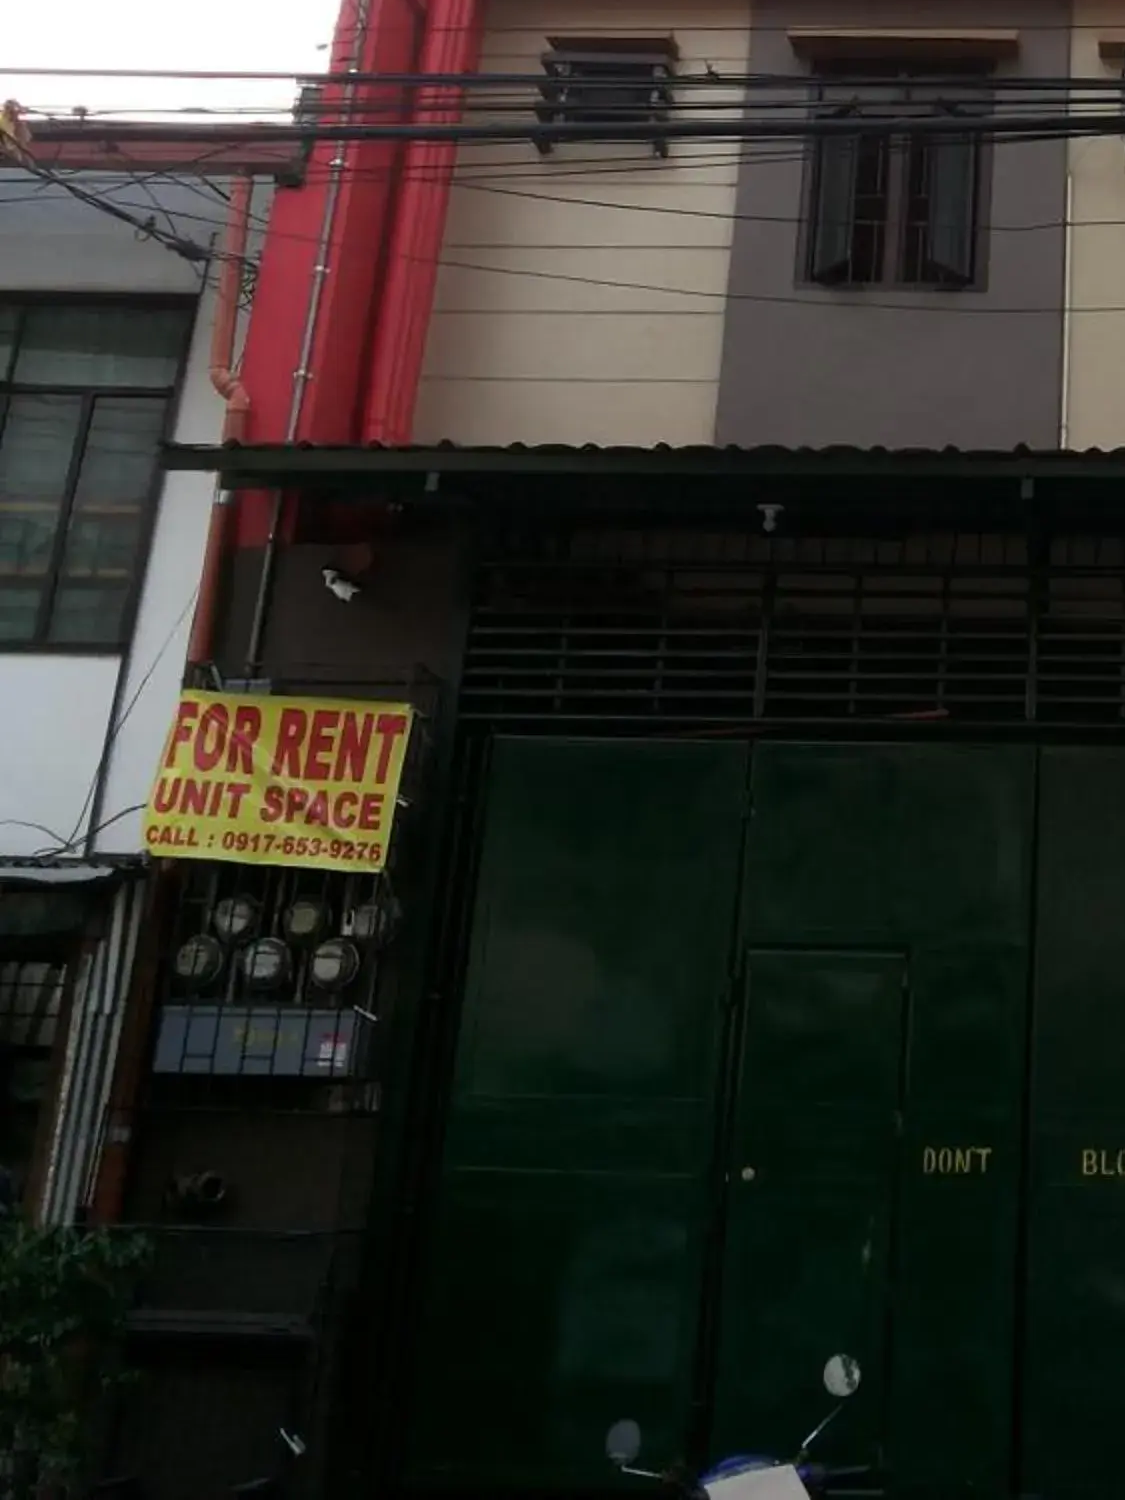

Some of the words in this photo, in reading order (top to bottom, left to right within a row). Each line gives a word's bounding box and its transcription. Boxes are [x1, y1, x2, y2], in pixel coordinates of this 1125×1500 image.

[164, 701, 261, 774] FOR
[272, 708, 407, 784] RENT
[154, 777, 252, 818] UNIT
[260, 786, 384, 830] SPACE
[146, 825, 199, 846] CALL
[922, 1146, 992, 1175] DON'T
